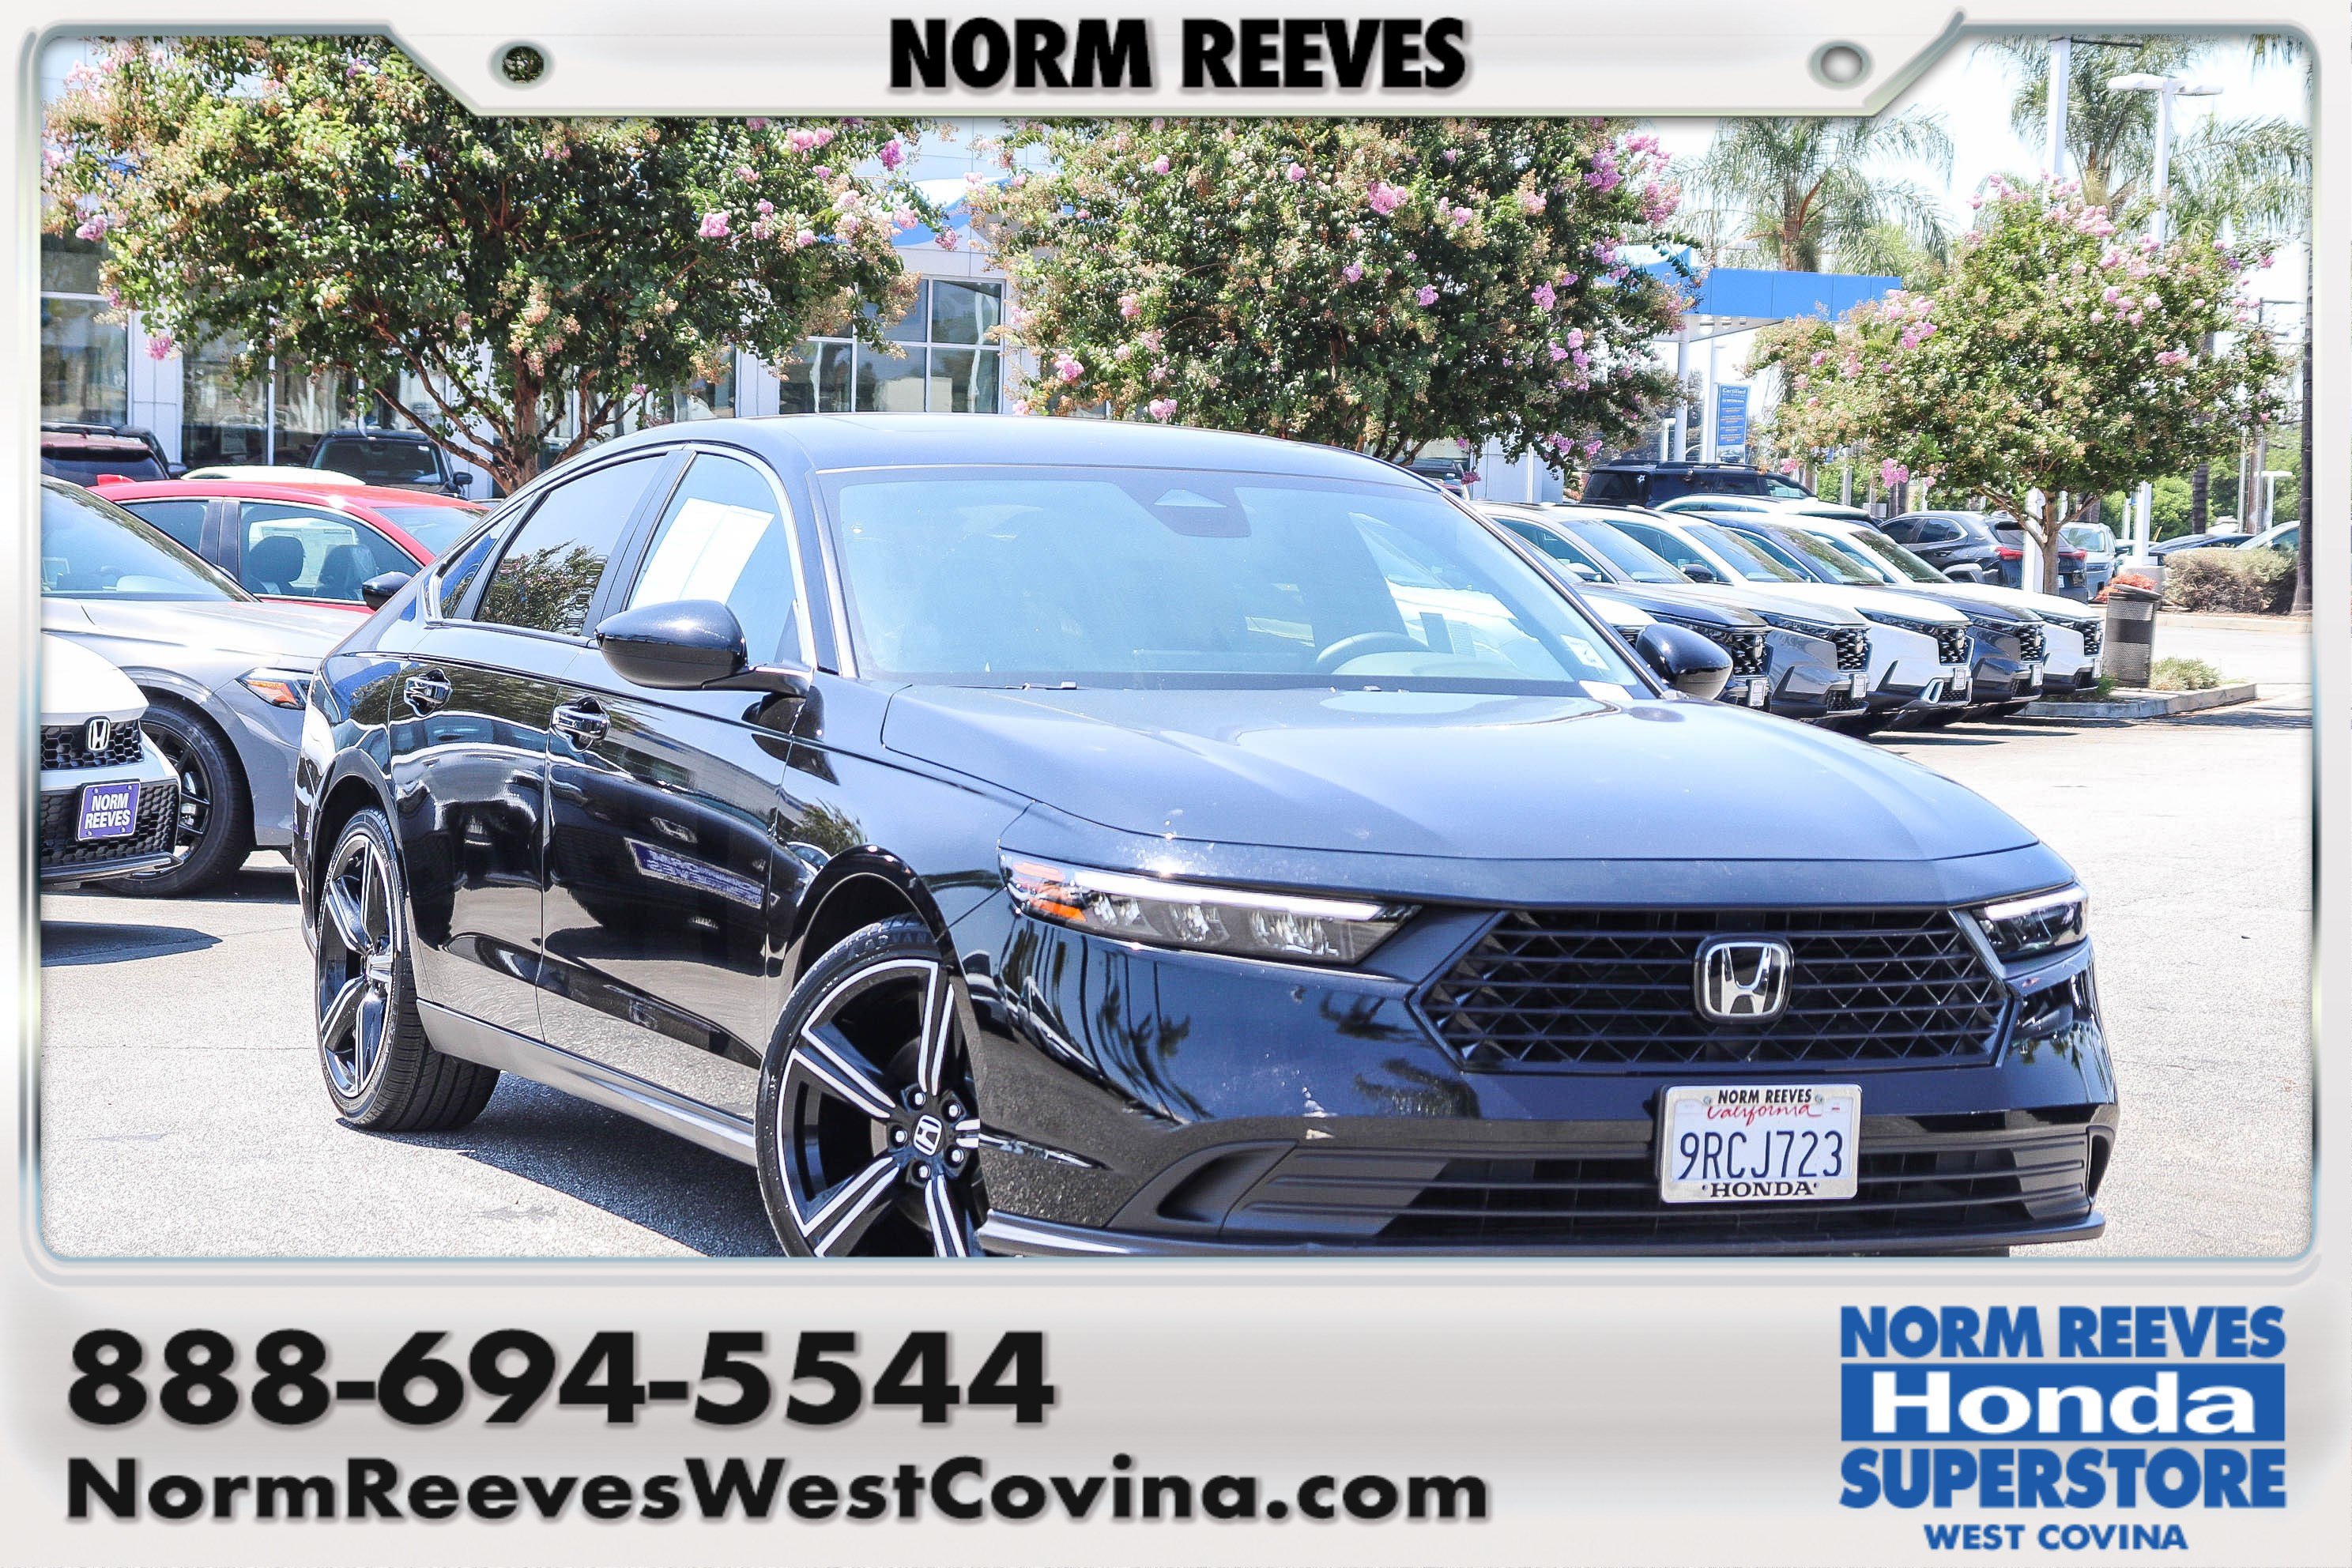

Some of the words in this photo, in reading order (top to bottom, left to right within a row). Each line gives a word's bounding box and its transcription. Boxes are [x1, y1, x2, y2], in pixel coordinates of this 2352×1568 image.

[91, 792, 130, 812] NORM
[84, 808, 131, 830] REEVES
[1717, 1089, 1760, 1105] NORM
[1765, 1088, 1812, 1104] REEVES
[1707, 1103, 1822, 1127] California
[1677, 1130, 1844, 1180] 9RCJ723
[1709, 1181, 1815, 1198] HONDA
